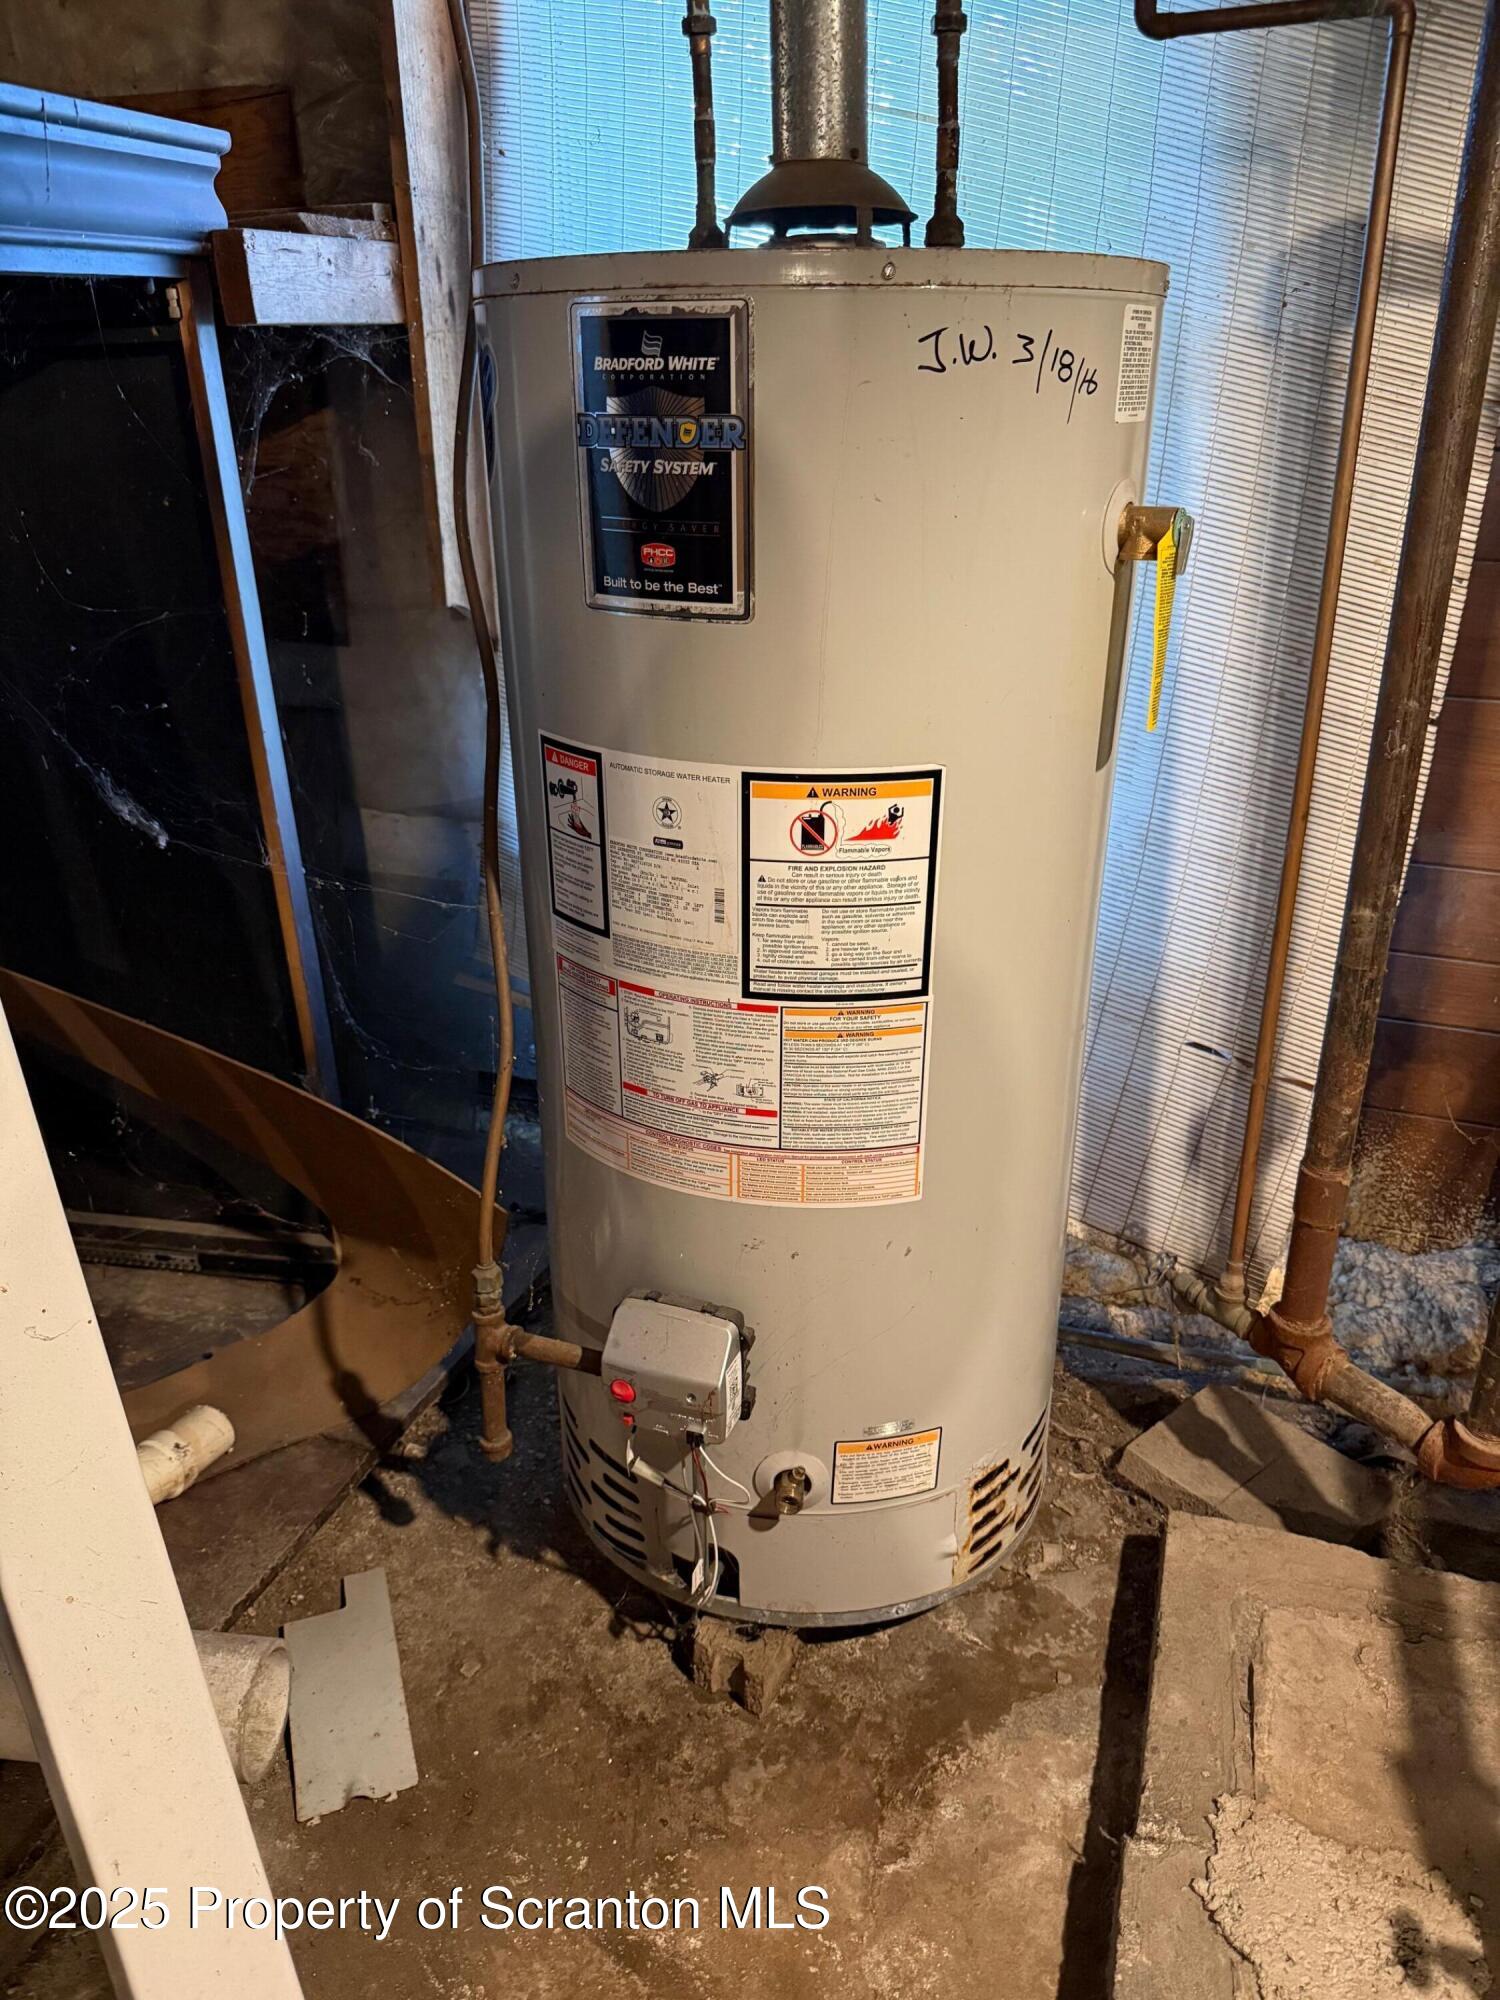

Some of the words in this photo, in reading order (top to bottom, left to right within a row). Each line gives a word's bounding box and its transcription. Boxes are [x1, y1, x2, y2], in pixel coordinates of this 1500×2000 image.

[918, 325, 996, 372] J.W.
[594, 356, 664, 371] BRADFORD
[668, 356, 716, 371] WHITE
[578, 414, 746, 449] DEFENDER
[600, 457, 651, 472] SAFETY
[653, 459, 714, 475] SYSTEM
[643, 547, 674, 557] PHCC
[603, 576, 628, 588] Built
[629, 580, 642, 590] to
[645, 580, 660, 591] be
[664, 582, 684, 593] the
[688, 582, 719, 595] Best
[560, 757, 589, 771] DANGER
[609, 762, 643, 774] AUTOMATIC
[644, 768, 675, 779] STORAGE
[676, 772, 701, 782] WATER
[702, 775, 731, 784] HEATER
[822, 787, 877, 797] WARNING
[690, 998, 732, 1008] INSTRUCTIONS
[873, 1438, 914, 1450] WARNING
